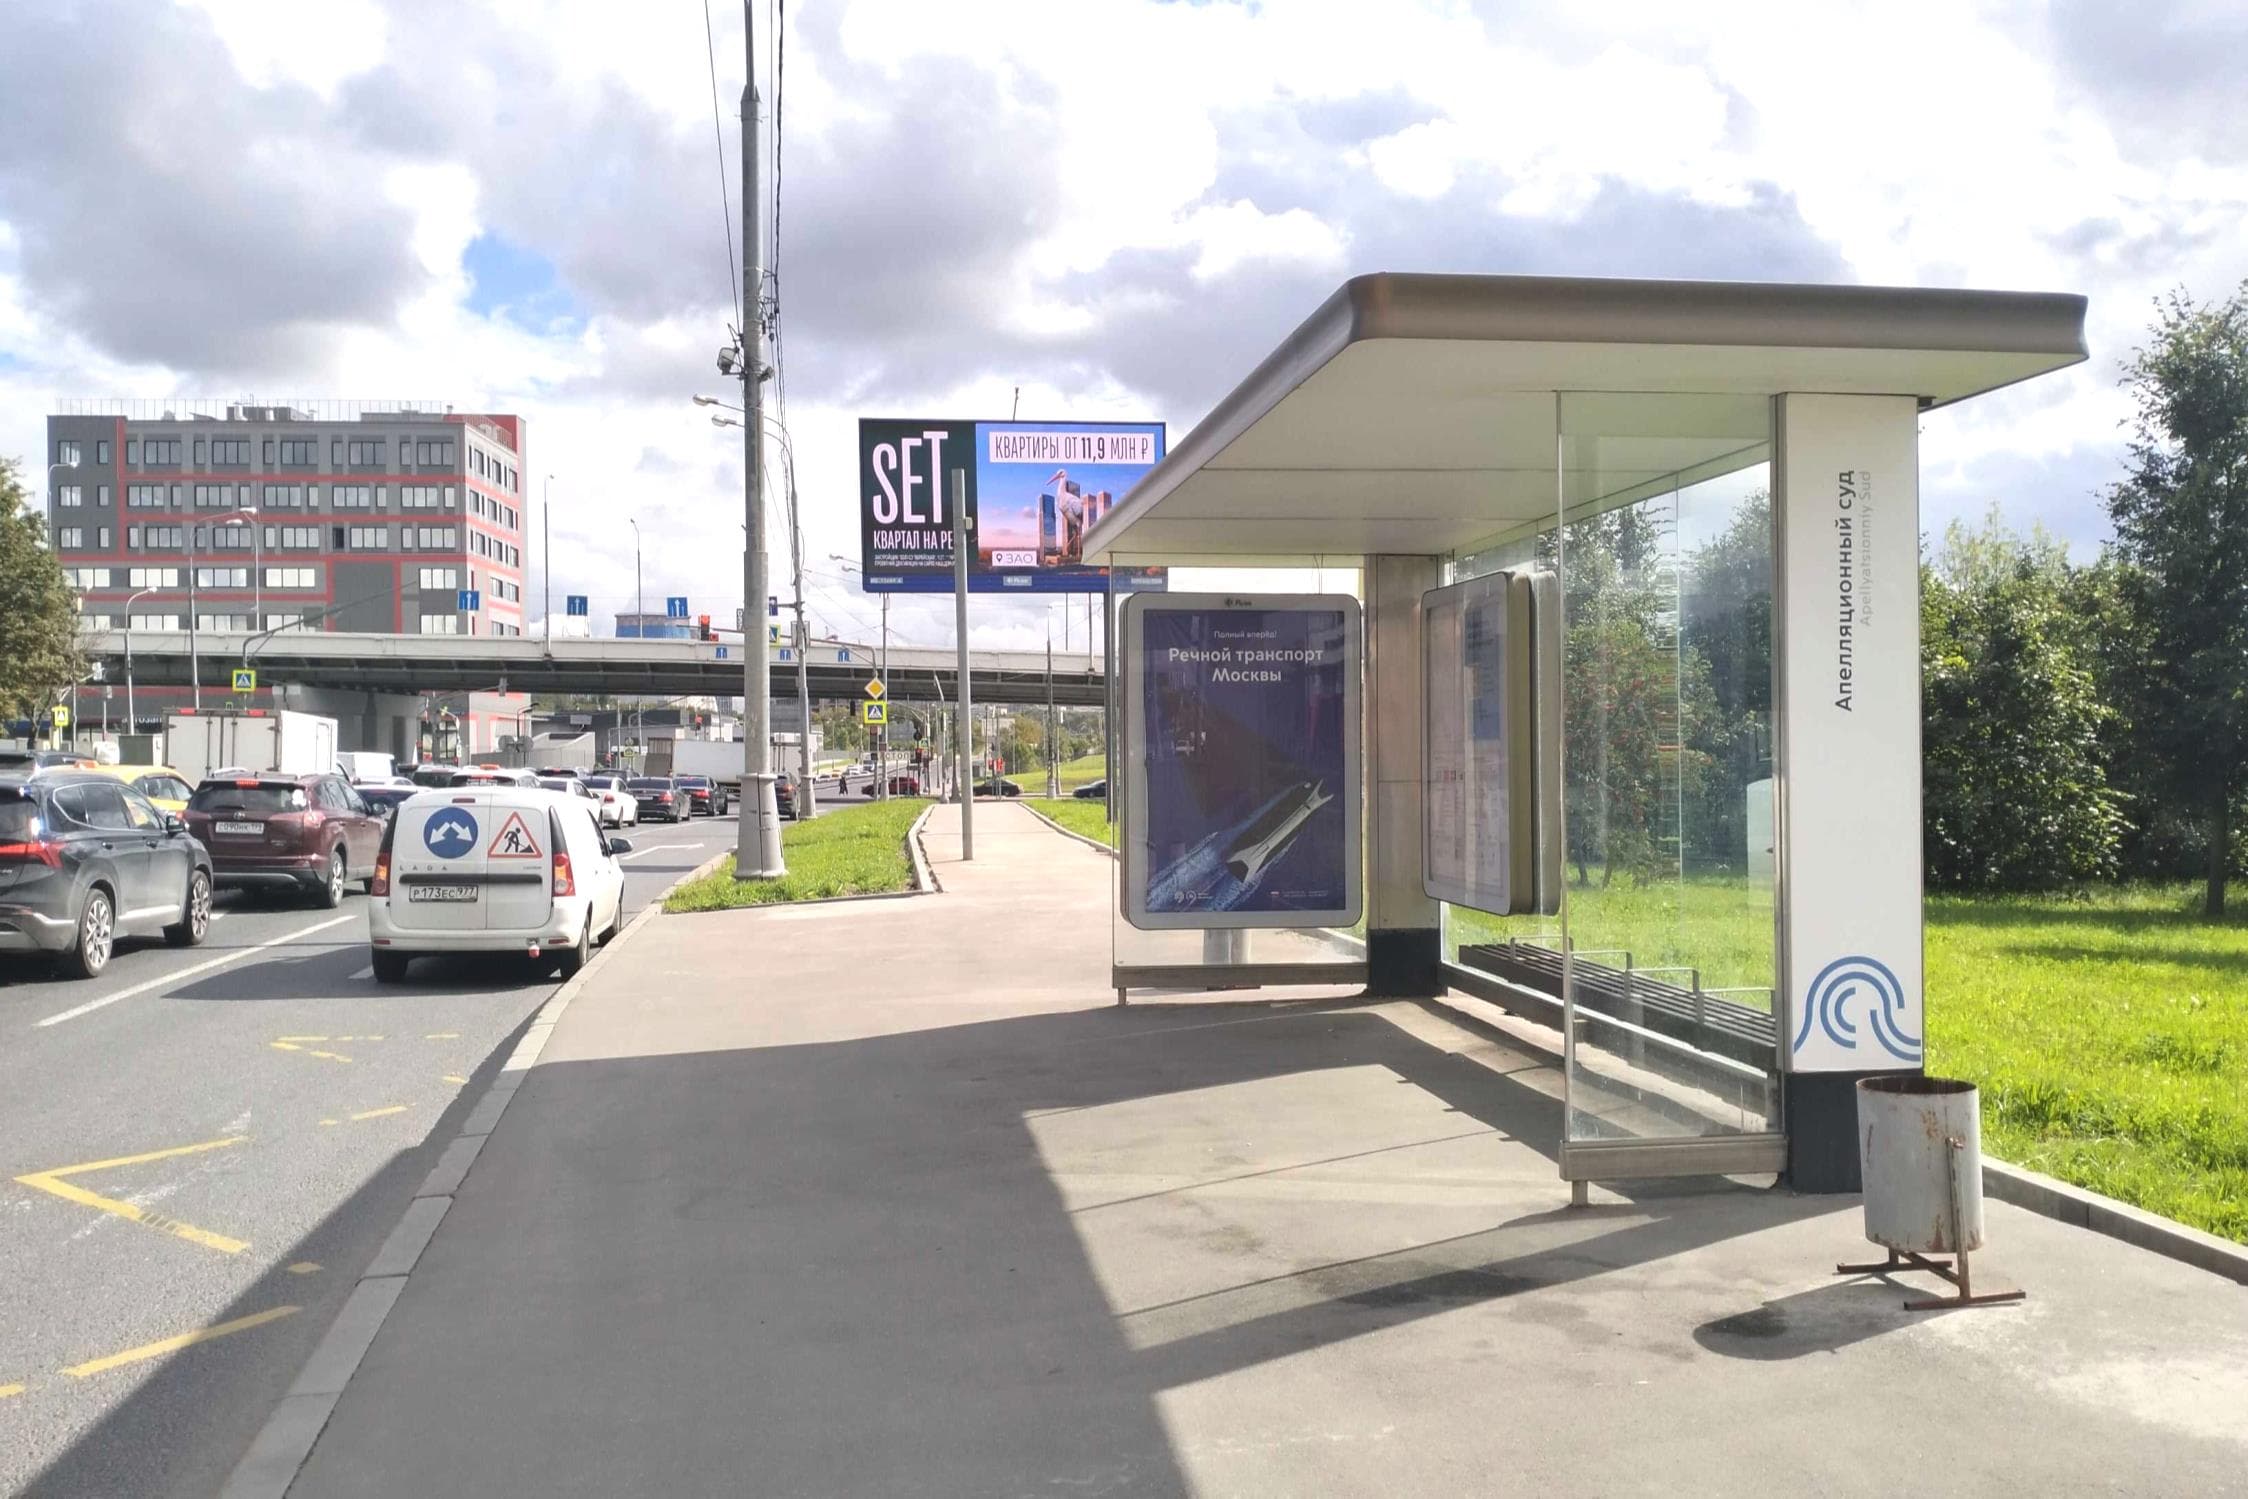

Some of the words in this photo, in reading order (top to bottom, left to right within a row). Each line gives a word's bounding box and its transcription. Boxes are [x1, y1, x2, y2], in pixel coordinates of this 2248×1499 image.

[995, 435, 1059, 459] КВАРТИРЫ
[1064, 436, 1077, 459] ОТ
[1081, 437, 1105, 462] 11,9
[1110, 437, 1136, 460] МЛН
[872, 431, 949, 524] SET
[1839, 470, 1856, 510] суд
[1858, 470, 1871, 501] Sud
[873, 530, 920, 550] КВАРТАЛ
[923, 530, 938, 550] НА
[1006, 552, 1034, 563] ЗАО
[1858, 503, 1874, 626] Apellyatsionniy
[1834, 517, 1855, 712] Апелляционный
[1214, 630, 1244, 639] Полный
[1168, 647, 1231, 662] Речной
[1236, 649, 1323, 665] транспорт
[1211, 668, 1282, 682] Москвы
